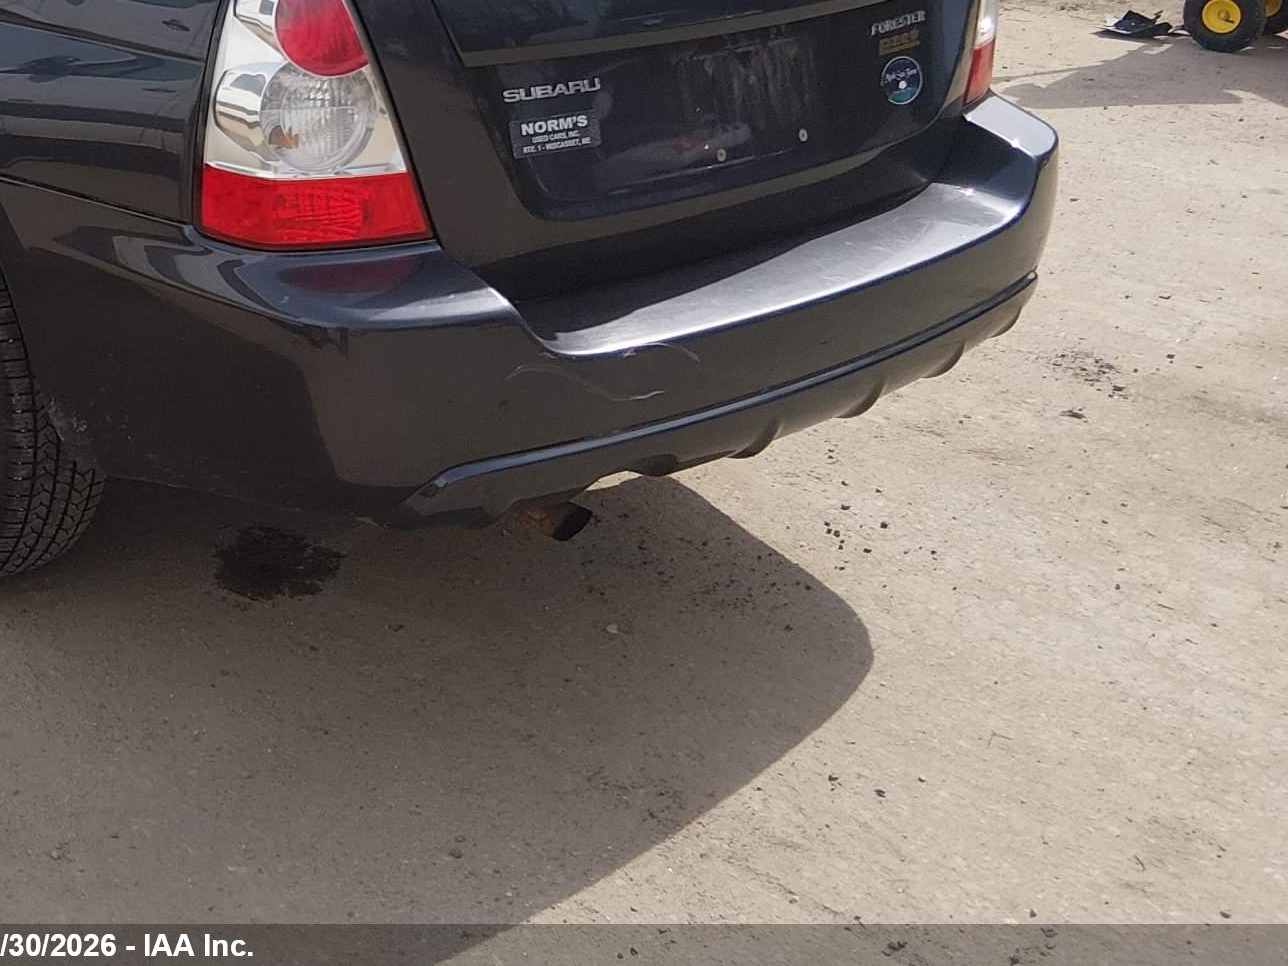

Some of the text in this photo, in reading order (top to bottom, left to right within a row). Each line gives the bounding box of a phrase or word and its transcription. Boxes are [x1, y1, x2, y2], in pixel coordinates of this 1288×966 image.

[871, 10, 926, 36] FORESTER
[502, 77, 601, 103] SUBARU
[520, 115, 588, 136] NORM'S
